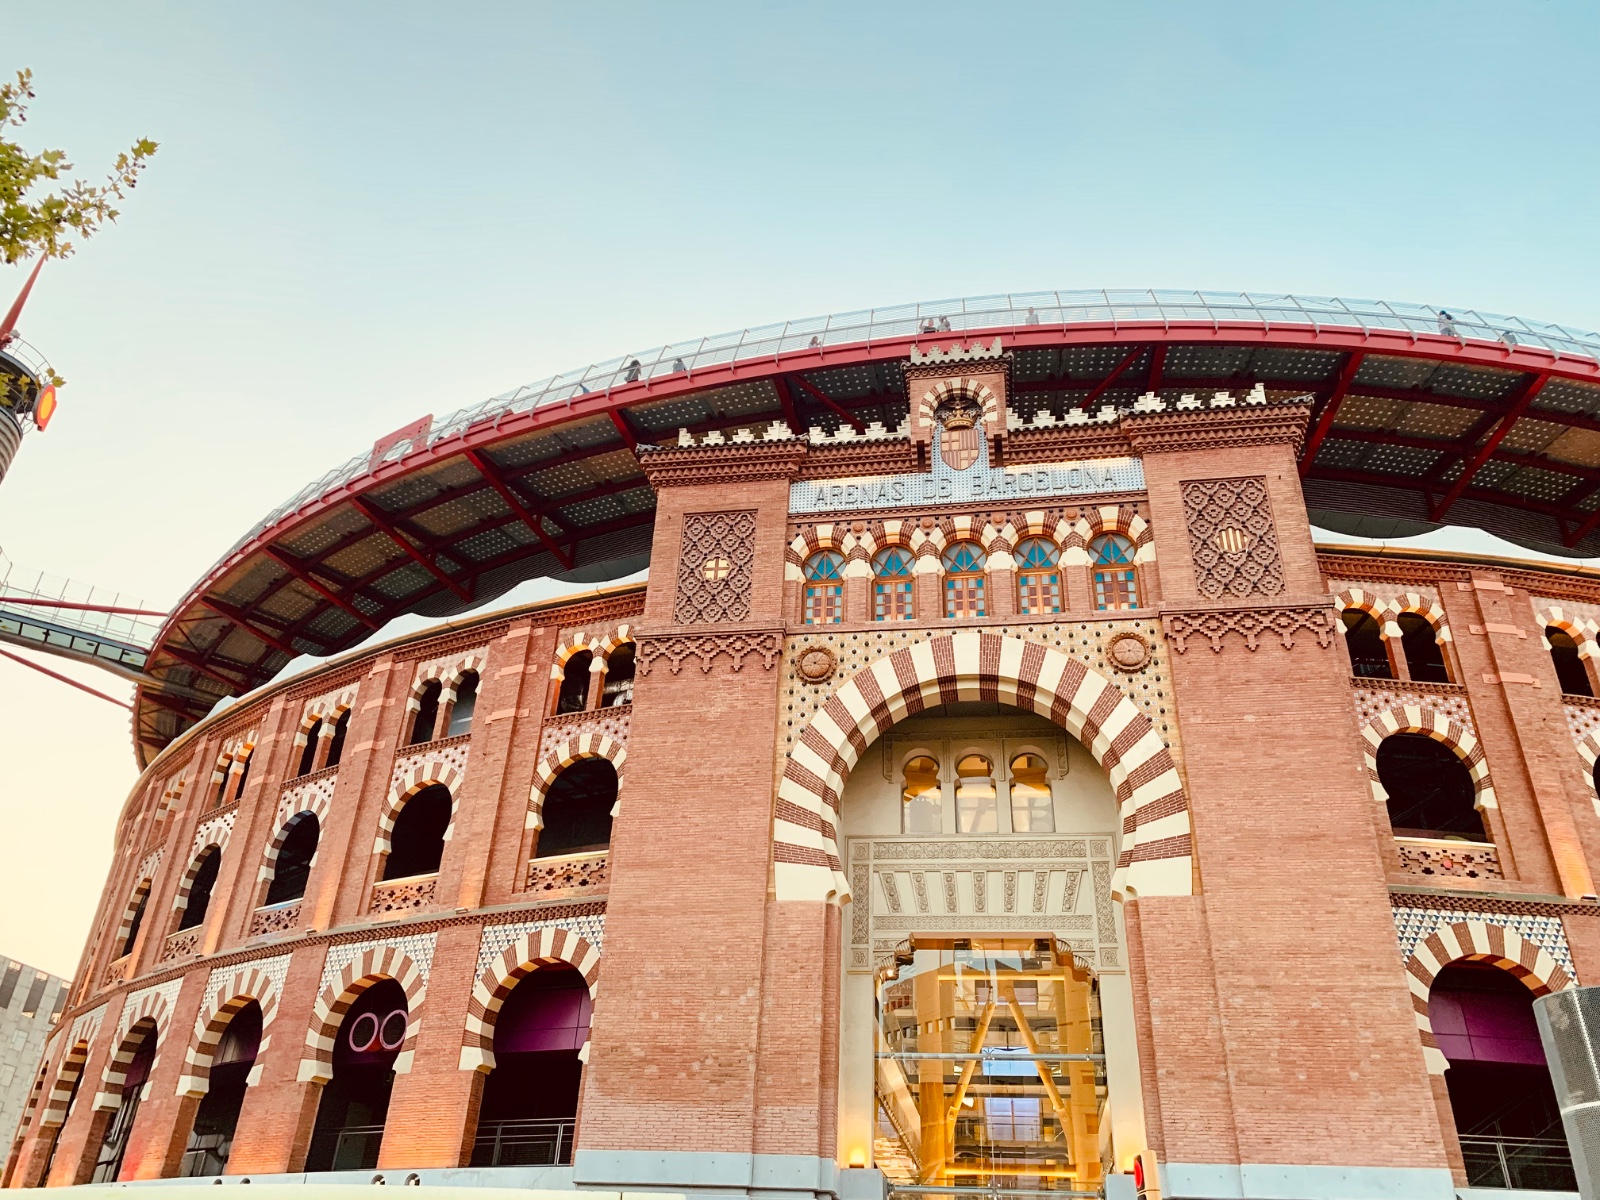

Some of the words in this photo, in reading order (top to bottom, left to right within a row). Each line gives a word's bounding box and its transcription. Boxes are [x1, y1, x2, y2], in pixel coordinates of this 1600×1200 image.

[813, 481, 905, 505] ARENAS
[922, 478, 952, 499] DE
[970, 467, 1118, 496] BARCELONA
